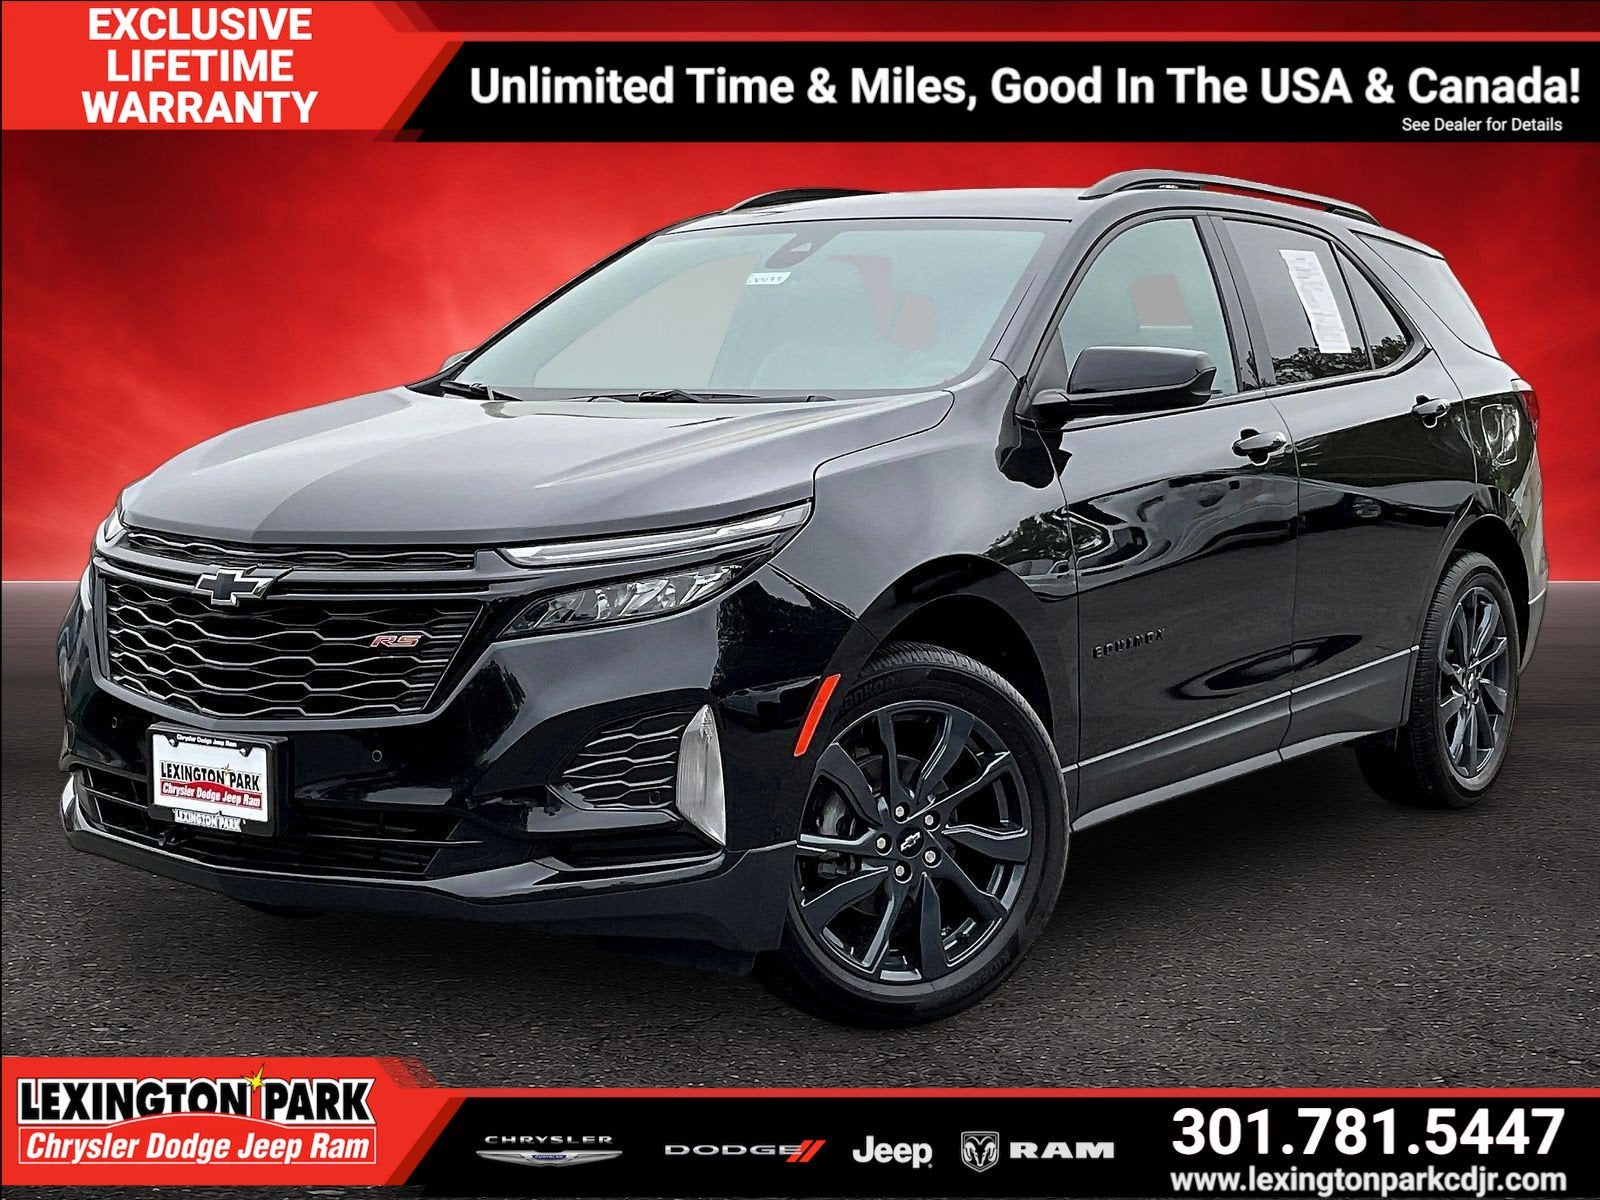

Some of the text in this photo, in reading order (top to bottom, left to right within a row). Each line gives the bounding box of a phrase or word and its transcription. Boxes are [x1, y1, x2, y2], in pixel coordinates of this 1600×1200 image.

[369, 635, 424, 648] RS
[161, 761, 260, 792] LEXINGTON PARK
[162, 782, 261, 808] Chrysler Dodge Jeep Ram
